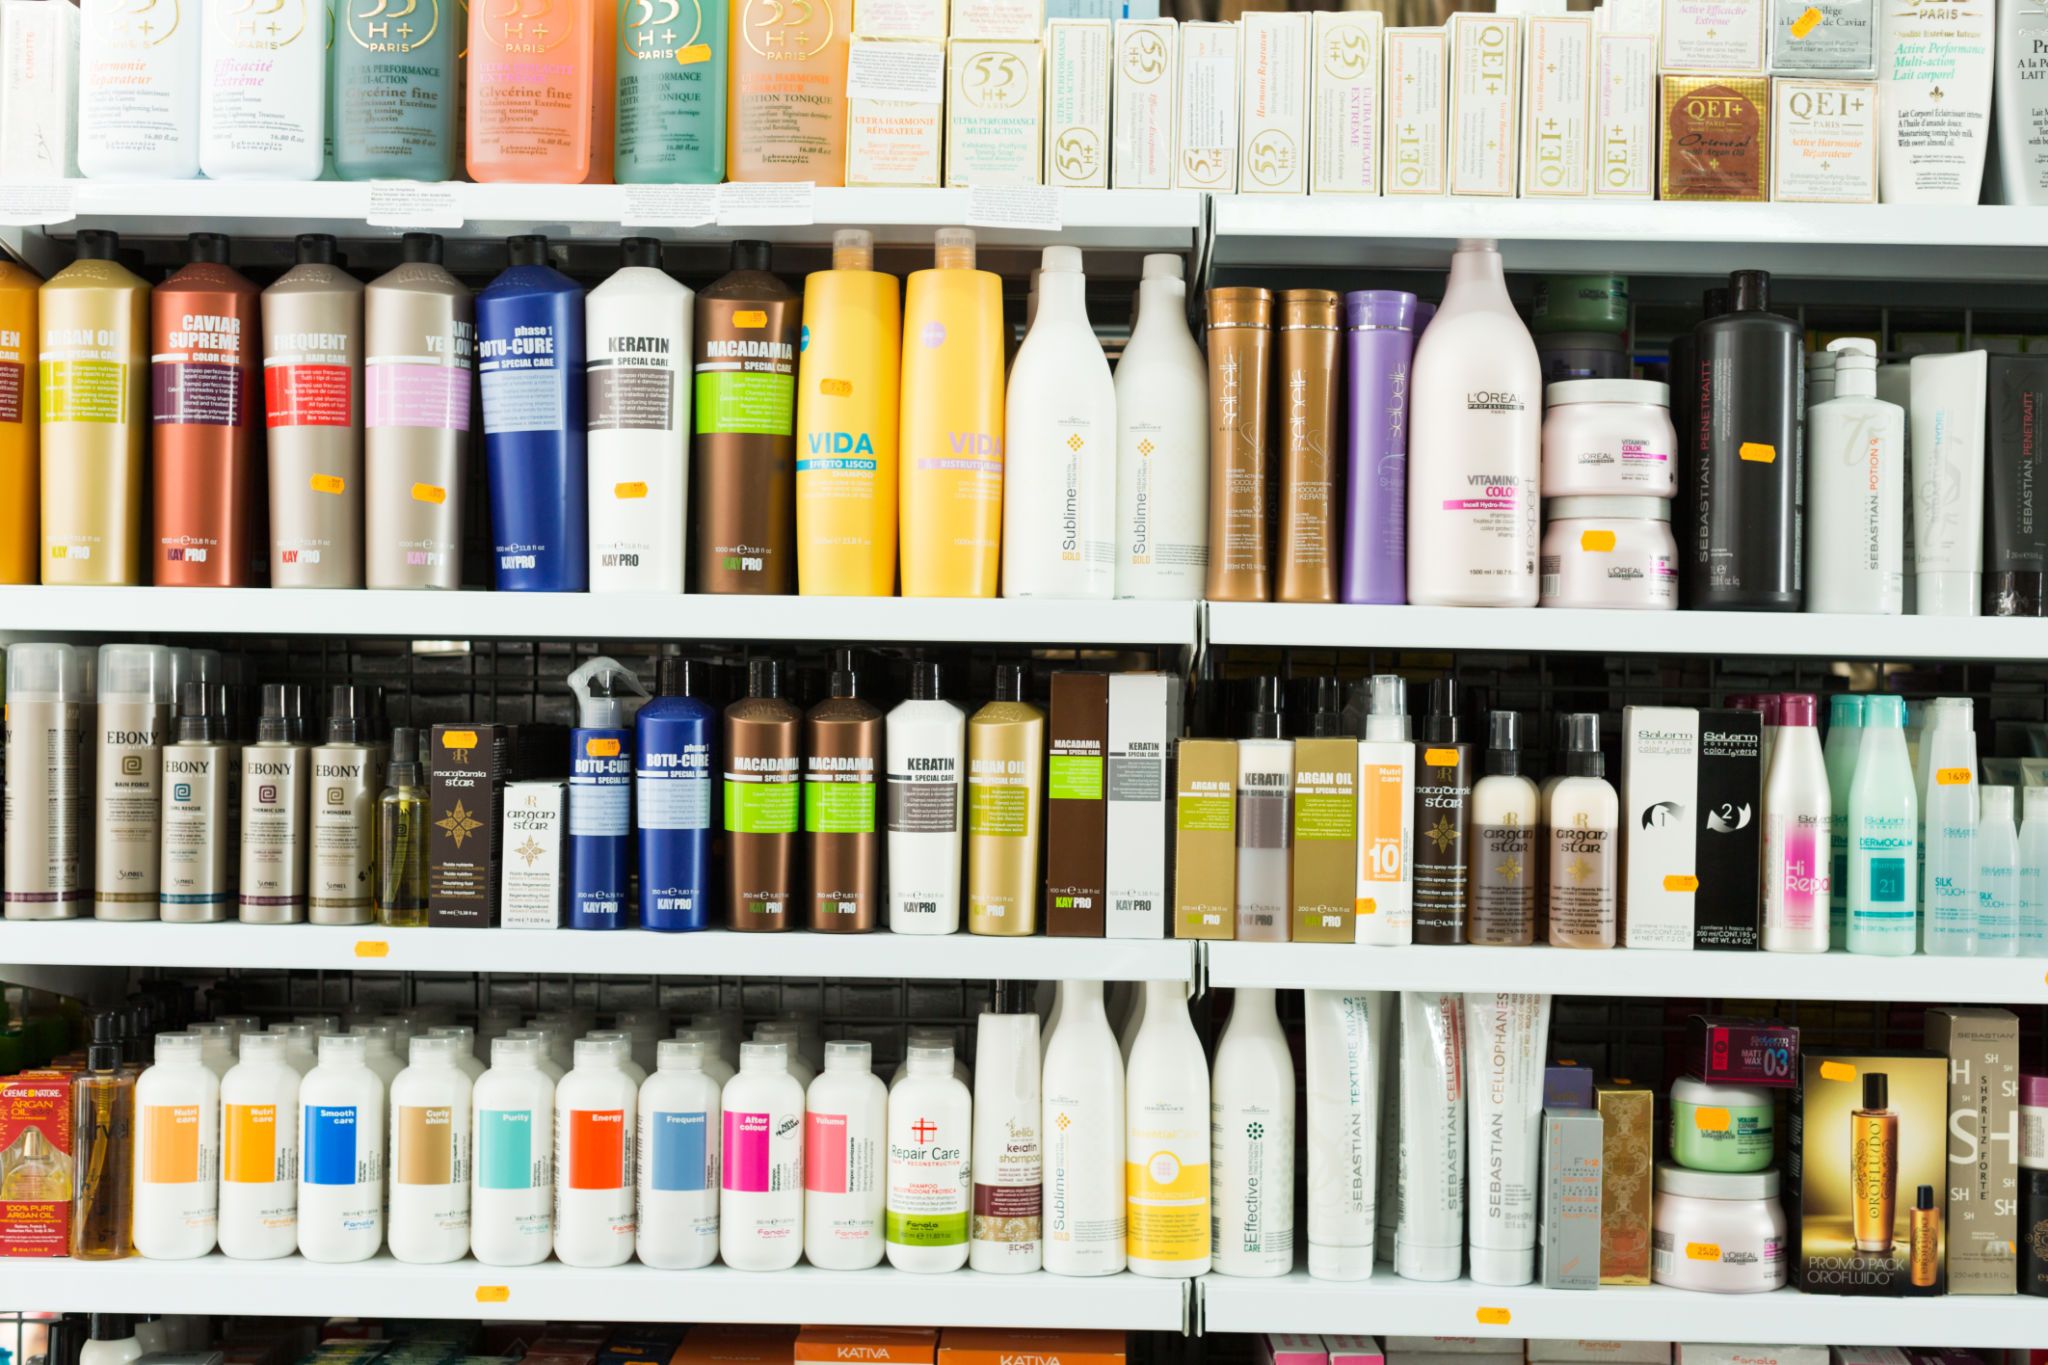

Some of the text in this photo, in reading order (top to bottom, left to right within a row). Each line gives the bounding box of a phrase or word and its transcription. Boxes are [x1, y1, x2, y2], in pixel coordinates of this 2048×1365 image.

[1919, 8, 1959, 20] PARIS
[1836, 18, 1866, 27] Caviar
[369, 43, 410, 53] PARIS
[505, 43, 545, 54] PARIS
[1894, 43, 1926, 55] Active
[638, 50, 674, 60] PARIS
[767, 52, 807, 61] PARIS
[1892, 68, 1956, 82] Lait corporel
[2021, 71, 2046, 80] LAIT
[411, 87, 439, 101] fine
[546, 88, 573, 100] fine
[885, 117, 935, 126] HARMONIE
[1813, 120, 1841, 128] PARIS
[182, 314, 241, 334] CAVIAR
[514, 325, 547, 338] phase
[169, 332, 240, 351] SUPREME
[273, 333, 347, 350] FREQUENT
[479, 337, 554, 358] BOTU-CURE
[607, 336, 670, 355] KERATIN
[707, 340, 793, 360] MACADAMIA
[192, 352, 241, 364] COLOR CARE
[320, 354, 347, 364] CARE
[501, 358, 555, 368] SPECIAL CARE
[617, 356, 669, 366] SPECIAL CARE
[744, 361, 793, 373] SPECIAL CARE
[808, 432, 874, 454] VIDA
[844, 460, 874, 469] LISCIO
[1870, 452, 1880, 492] POTION
[1467, 475, 1519, 486] VITAMINO
[1062, 488, 1077, 550] Sublime
[1526, 479, 1536, 549] expert
[1132, 493, 1147, 554] Sublime
[282, 550, 320, 564] KAYPRO
[501, 554, 536, 569] KAYPRO
[601, 553, 639, 567] KAYPRO
[1062, 551, 1081, 561] GOLD
[1131, 555, 1151, 565] GOLD
[722, 557, 763, 571] KAYPRO
[107, 731, 160, 745] EBONY
[1703, 731, 1758, 742] Salerm
[1054, 739, 1100, 749] MACADAMIA
[1128, 742, 1159, 751] KERATIN
[1703, 747, 1728, 756] color
[646, 754, 709, 767] BOTU-CURE
[734, 757, 800, 771] MACADAMIA
[907, 757, 955, 771] KERATIN
[1007, 759, 1025, 774] OIL
[165, 761, 210, 774] EBONY
[247, 762, 292, 775] EBONY
[315, 765, 361, 778] EBONY
[1379, 768, 1402, 776] Nutri
[670, 770, 690, 778] SPECIAL
[764, 774, 788, 783] SPECIAL
[834, 774, 858, 782] SPECIAL
[914, 774, 954, 782] SPECIAL CARE
[1297, 772, 1353, 785] ARGAN OIL
[445, 777, 475, 787] star
[1191, 781, 1232, 791] ARGAN OIL
[1425, 795, 1463, 808] star
[507, 810, 556, 821] argan
[1721, 803, 1732, 819] 2
[513, 820, 549, 830] star
[1483, 829, 1534, 845] argan
[1556, 829, 1608, 845] argan
[1490, 840, 1528, 853] star
[1561, 840, 1602, 853] star
[1369, 844, 1399, 873] 10
[1785, 860, 1805, 876] Hi
[1879, 878, 1896, 894] 21
[1935, 878, 1952, 887] SILK
[1935, 888, 1966, 897] TOUCH
[1979, 892, 1993, 900] SILK
[583, 901, 618, 914] KAYPRO
[657, 898, 692, 911] KAYPRO
[749, 902, 783, 914] KAYPRO
[903, 902, 936, 914] KAYPRO
[1055, 896, 1092, 909] KAYPRO
[1115, 900, 1152, 912] KAYPRO
[1744, 1056, 1762, 1065] WAX
[1764, 1047, 1789, 1077] 03
[1984, 1053, 1999, 1064] SH
[2003, 1064, 2013, 1072] SH
[1350, 1044, 1361, 1106] TEXTURE
[3, 1089, 28, 1098] CREME
[11, 1108, 30, 1116] OIL
[320, 1109, 355, 1117] Smooth
[426, 1109, 449, 1119] Curly
[1980, 1075, 1988, 1144] SHPRITZ
[425, 1117, 449, 1125] shine
[502, 1114, 529, 1123] Purity
[592, 1114, 622, 1123] Energy
[666, 1115, 705, 1124] Frequent
[745, 1116, 768, 1124] After
[815, 1117, 845, 1125] Volume
[739, 1124, 768, 1132] colour
[891, 1144, 960, 1161] Repair Care
[1006, 1144, 1038, 1153] keratin
[998, 1154, 1040, 1164] shampoo
[1869, 1121, 1883, 1219] OROFLUIDO
[2002, 1178, 2016, 1188] SH
[1053, 1167, 1065, 1231] Sublime
[1951, 1188, 1969, 1200] SH
[6, 1204, 55, 1212] 100% PURE
[1246, 1177, 1259, 1244] Effective
[1994, 1199, 2016, 1217] SH
[7, 1211, 55, 1219] ARGAN OIL
[1963, 1211, 1975, 1220] SH
[906, 1220, 939, 1228] Fanola
[1809, 1256, 1905, 1272] PROMO PACK
[1807, 1270, 1889, 1285] OROFLUIDO
[837, 1346, 890, 1359] KATIVA
